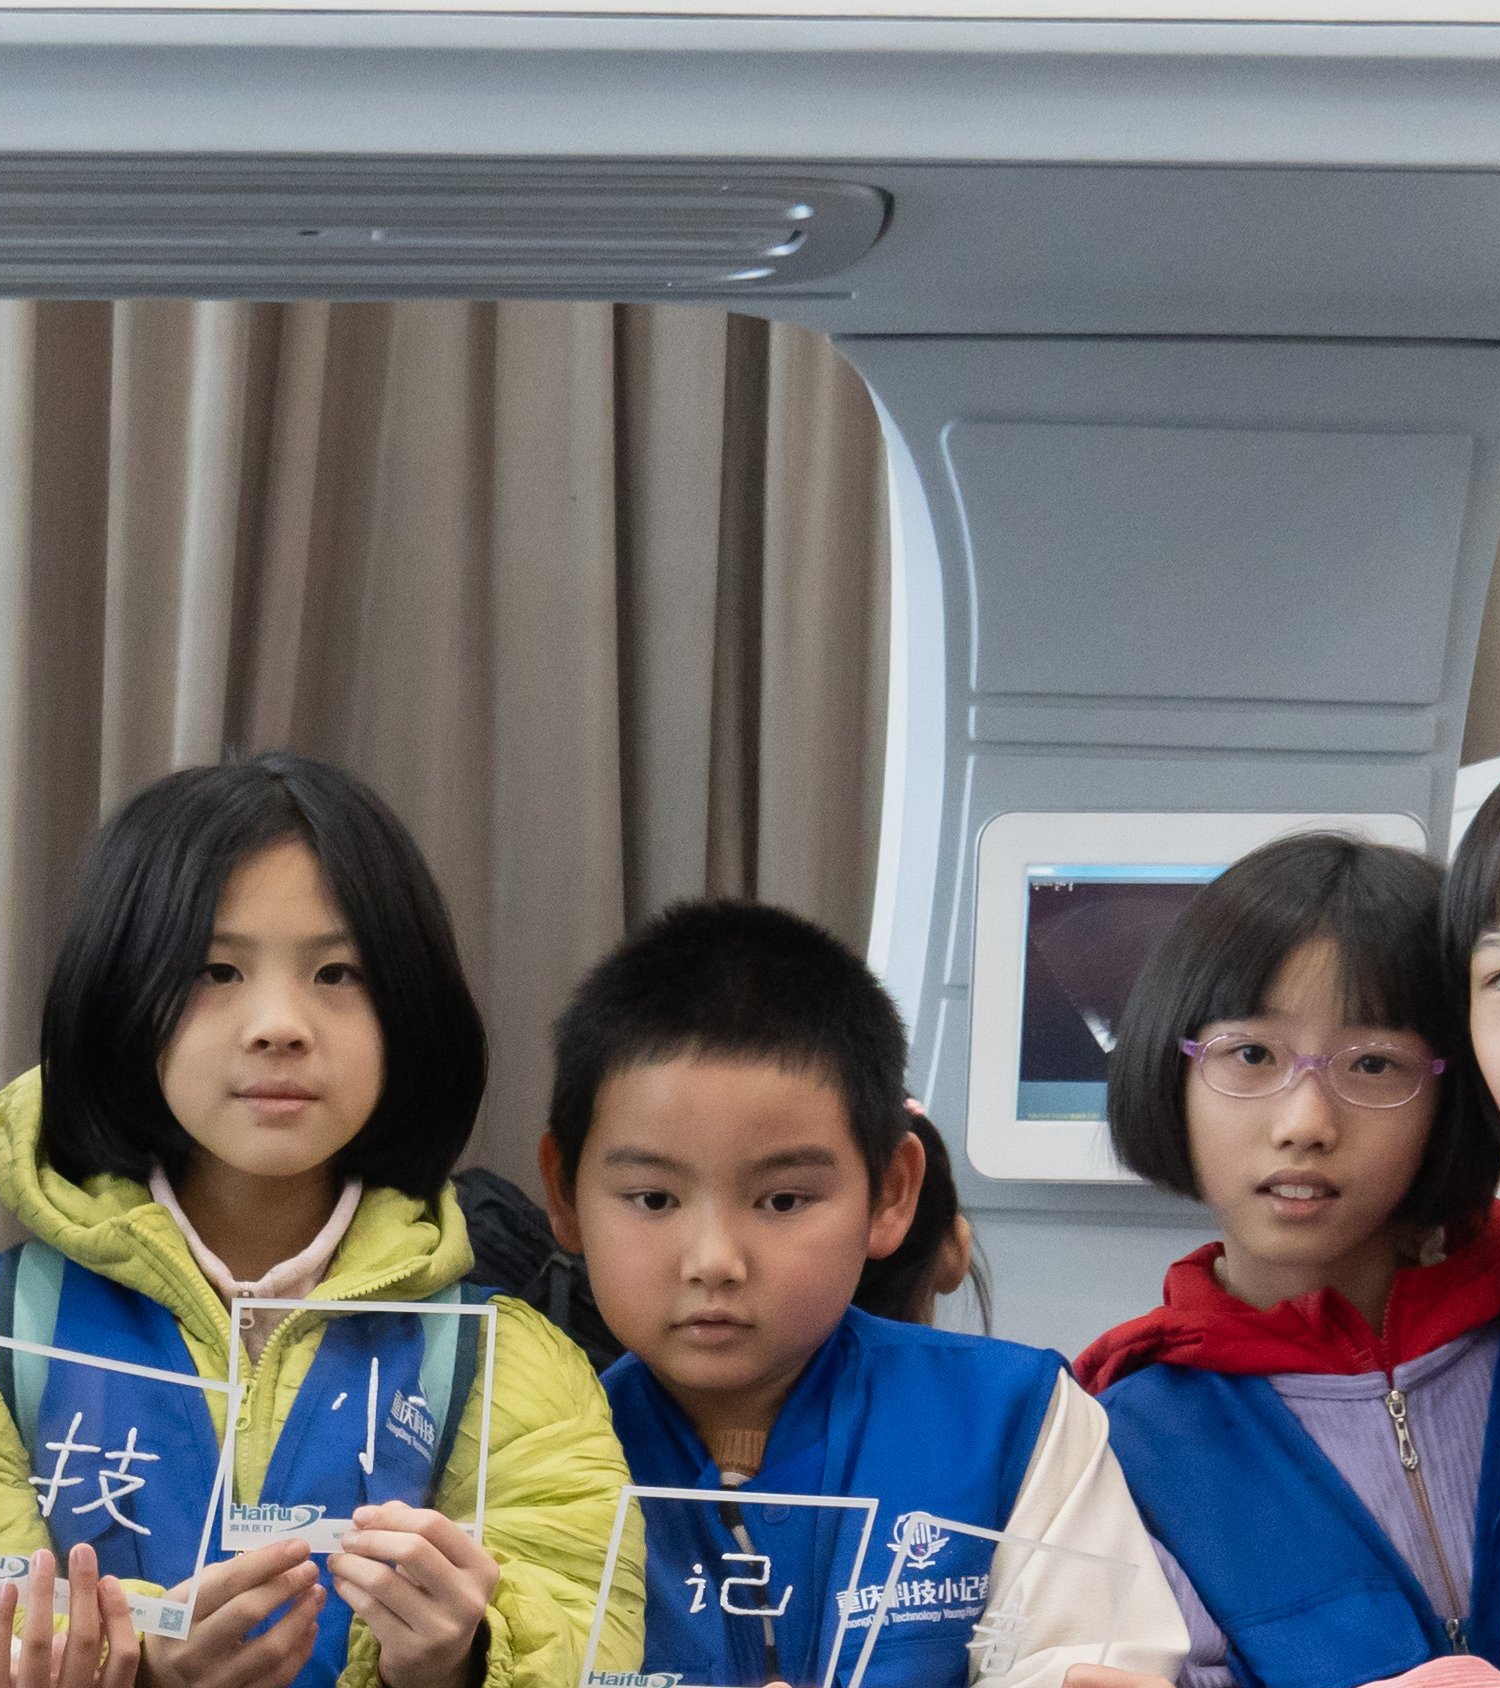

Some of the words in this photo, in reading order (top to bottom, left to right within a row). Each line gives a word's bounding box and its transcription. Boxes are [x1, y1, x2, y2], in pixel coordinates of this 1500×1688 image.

[331, 1356, 427, 1475] 小
[28, 1412, 161, 1536] 技
[229, 1503, 292, 1521] Haifu
[684, 1552, 793, 1617] 记
[891, 1611, 942, 1623] Technology
[587, 1670, 648, 1687] Haifu
